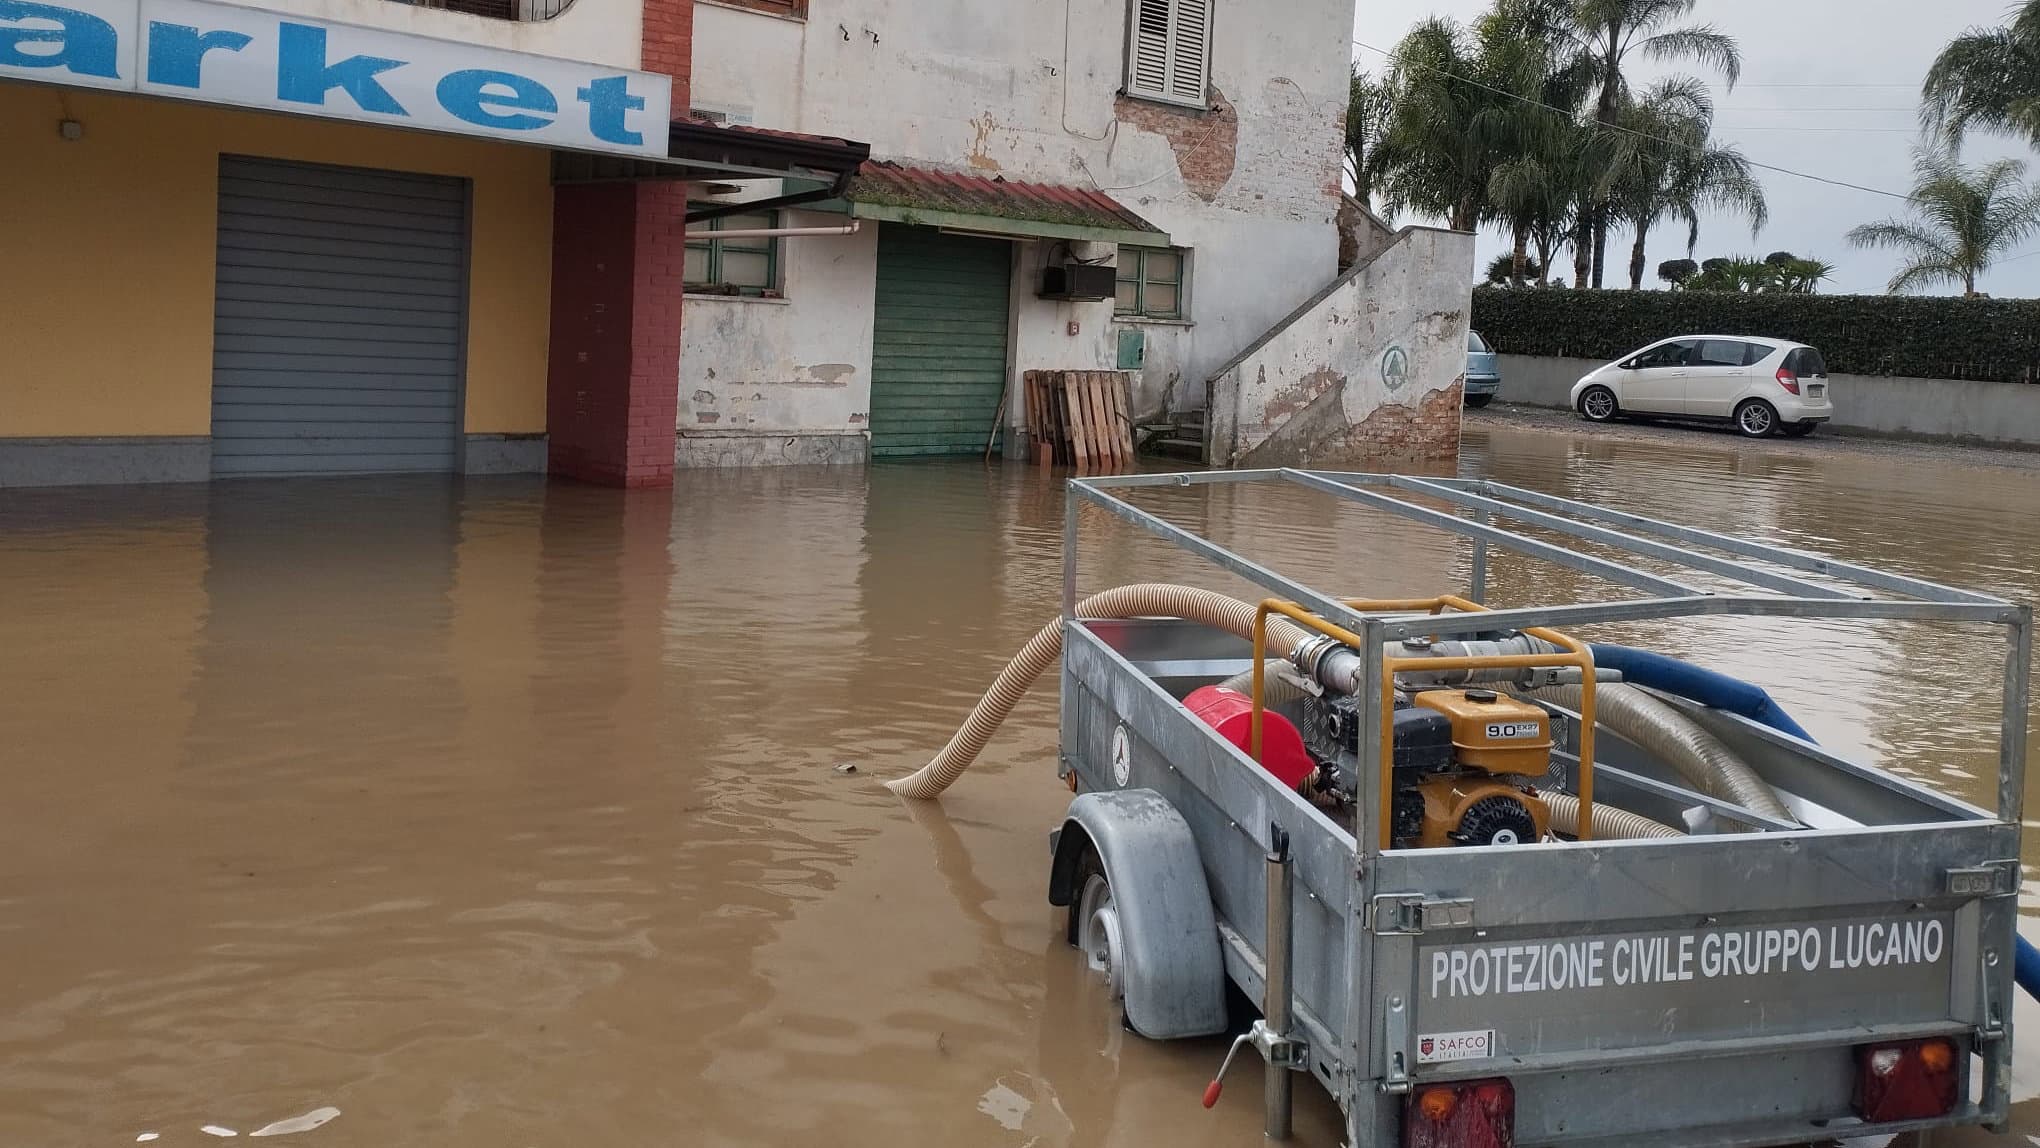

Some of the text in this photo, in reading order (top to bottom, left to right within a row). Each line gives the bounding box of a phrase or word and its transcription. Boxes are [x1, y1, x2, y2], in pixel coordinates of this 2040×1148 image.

[0, 0, 645, 146] arket
[1488, 725, 1516, 737] 9.0
[1431, 919, 1943, 998] PROTEZIONE CIVILE GRUPPO LUCANO
[1439, 1037, 1485, 1050] SAFCO
